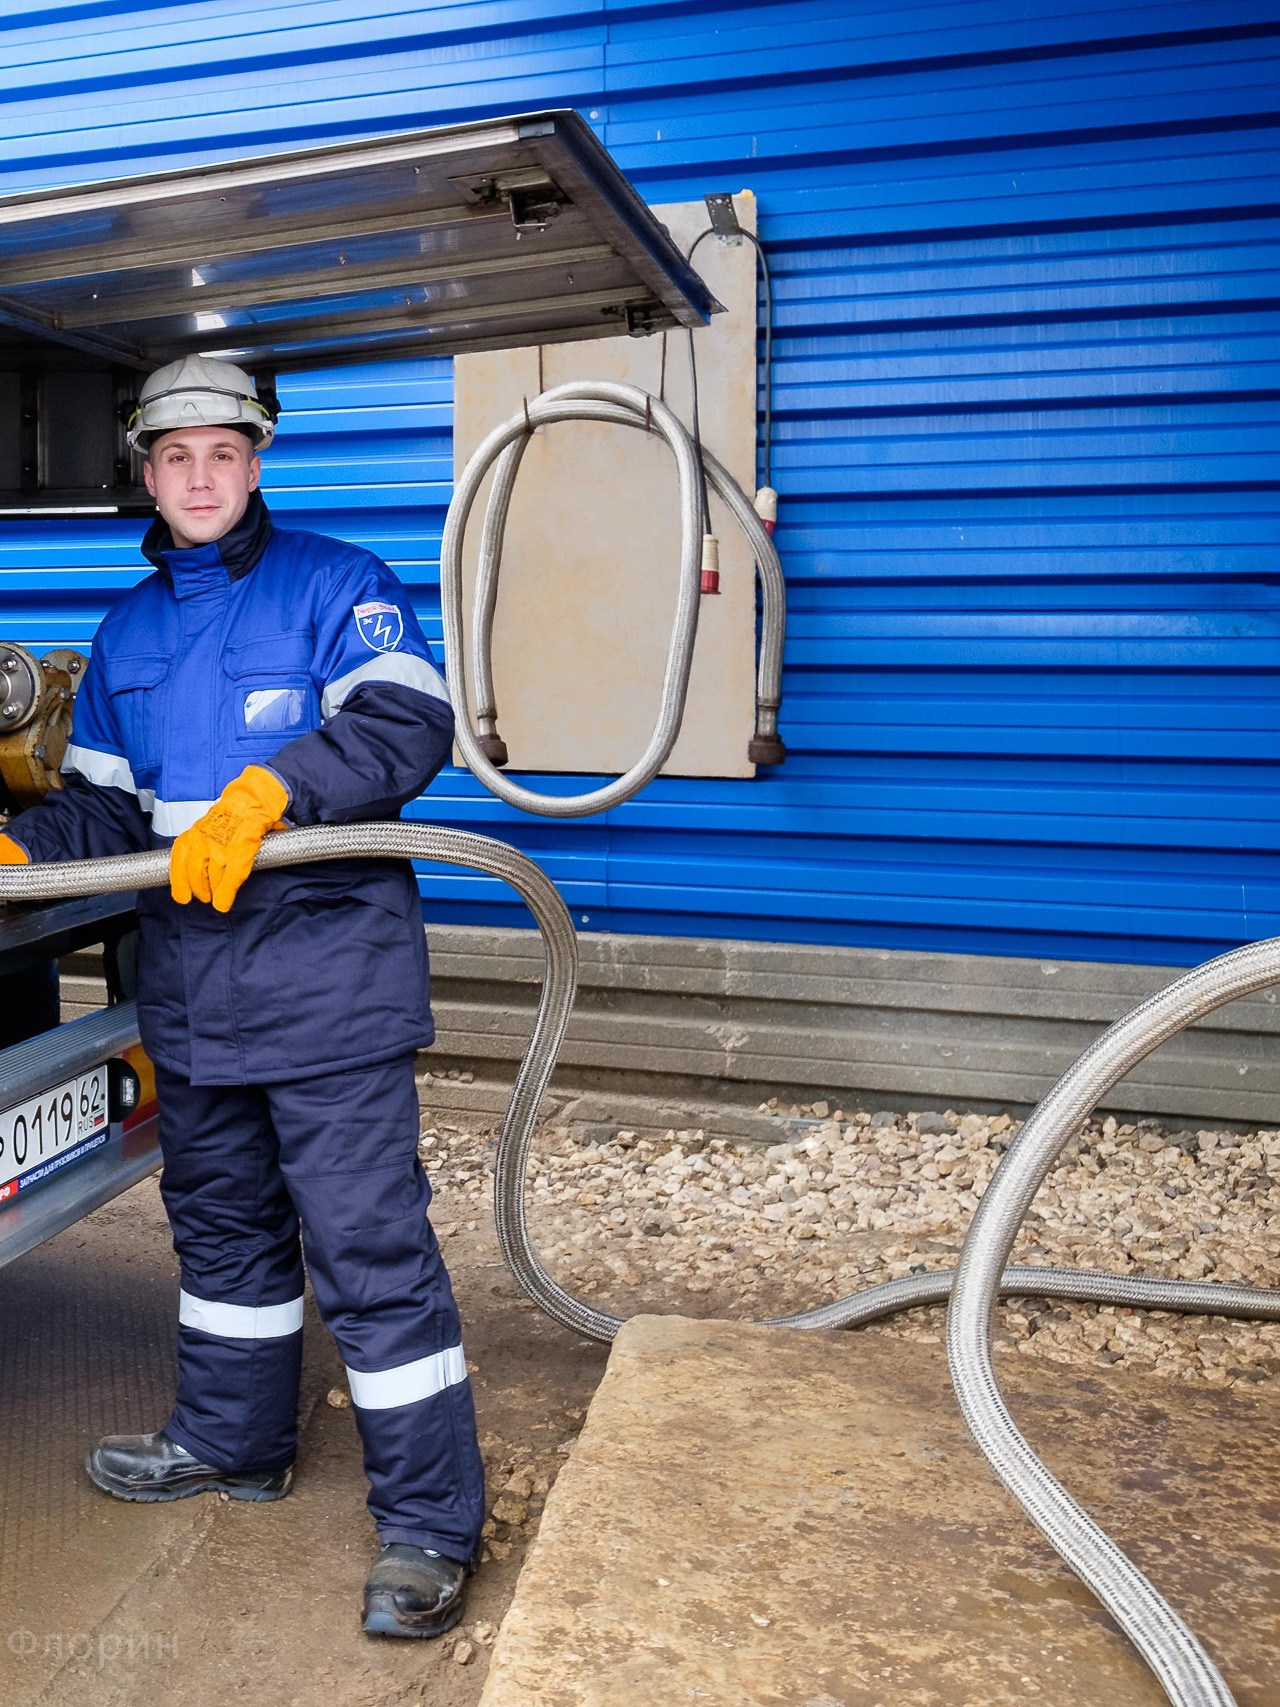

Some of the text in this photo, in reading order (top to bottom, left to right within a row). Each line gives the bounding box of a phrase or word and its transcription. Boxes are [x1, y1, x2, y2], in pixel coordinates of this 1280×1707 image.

[13, 1092, 73, 1165] 0119
[80, 1075, 100, 1117] 62
[78, 1116, 94, 1133] RUS
